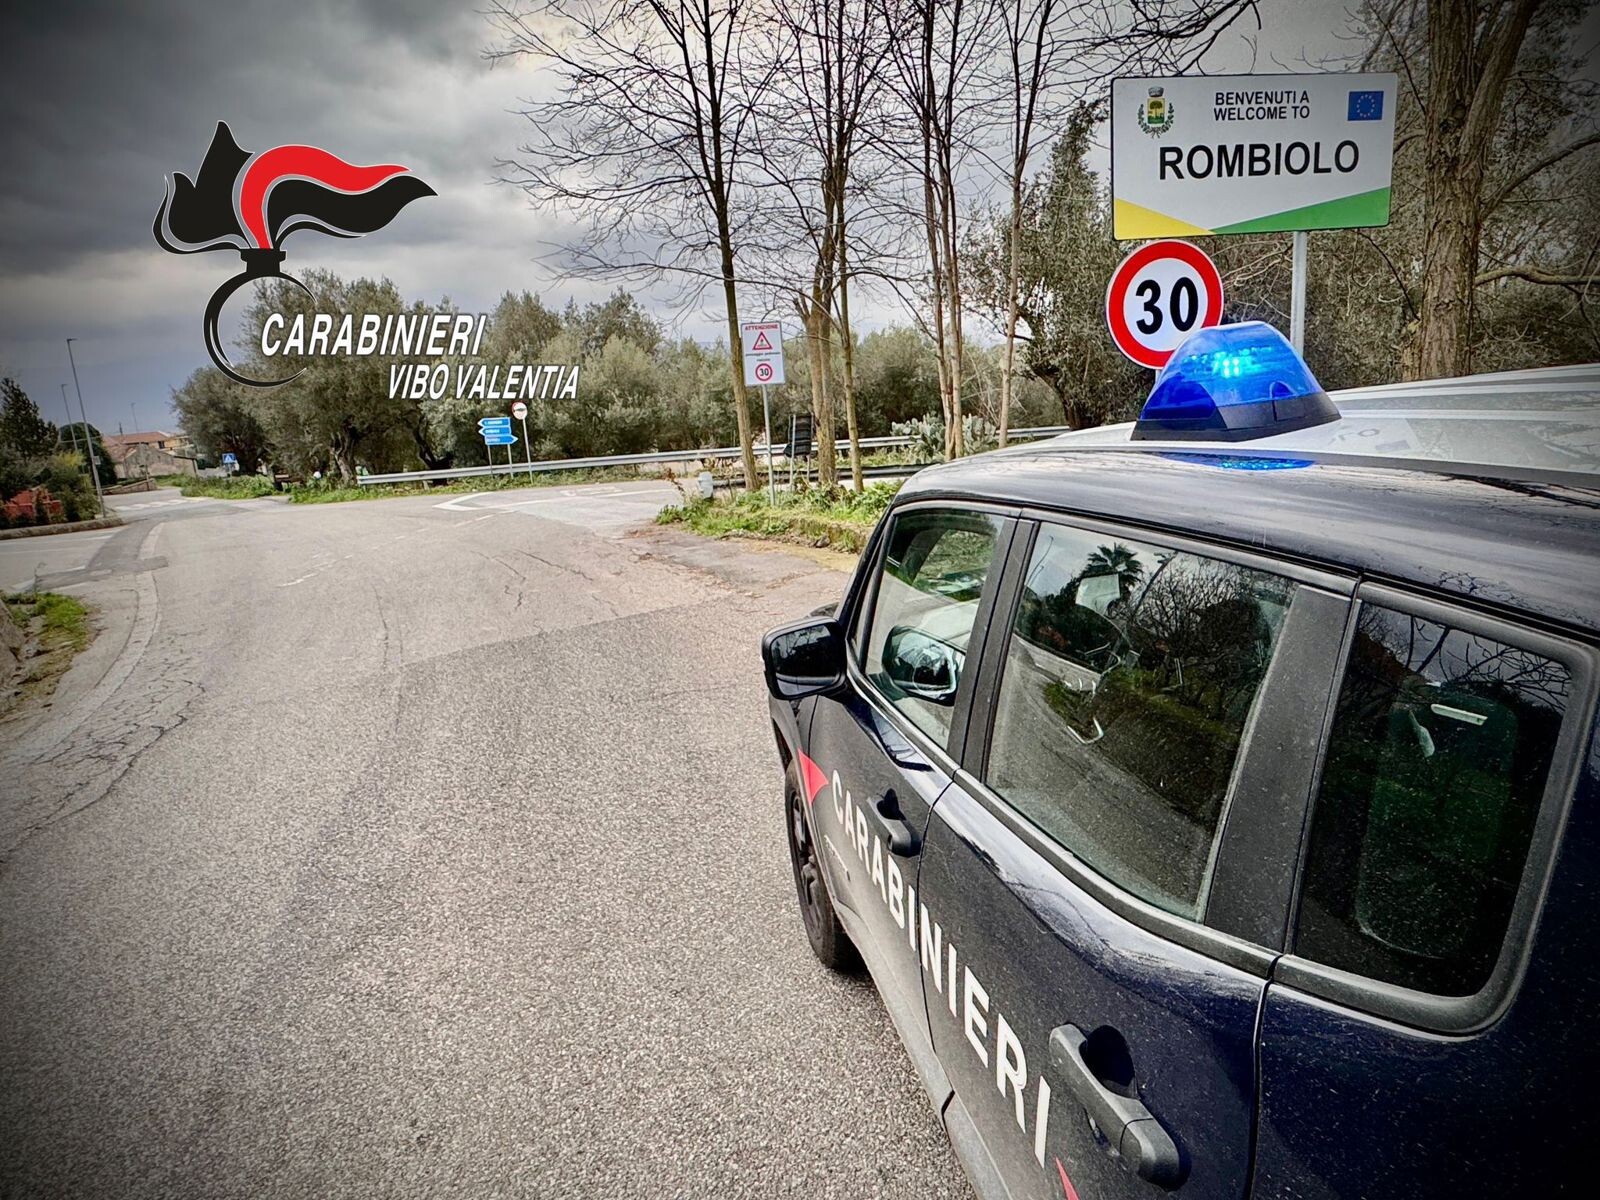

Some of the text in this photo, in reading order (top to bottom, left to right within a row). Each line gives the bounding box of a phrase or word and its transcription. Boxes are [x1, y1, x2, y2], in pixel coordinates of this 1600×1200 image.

[1215, 90, 1310, 106] BENVENUTI A
[1213, 105, 1310, 121] WELCOME TO
[1159, 140, 1360, 180] ROMBIOLO
[1135, 276, 1199, 335] 30
[759, 368, 769, 376] 30
[832, 769, 1051, 1168] CARABINIERI
